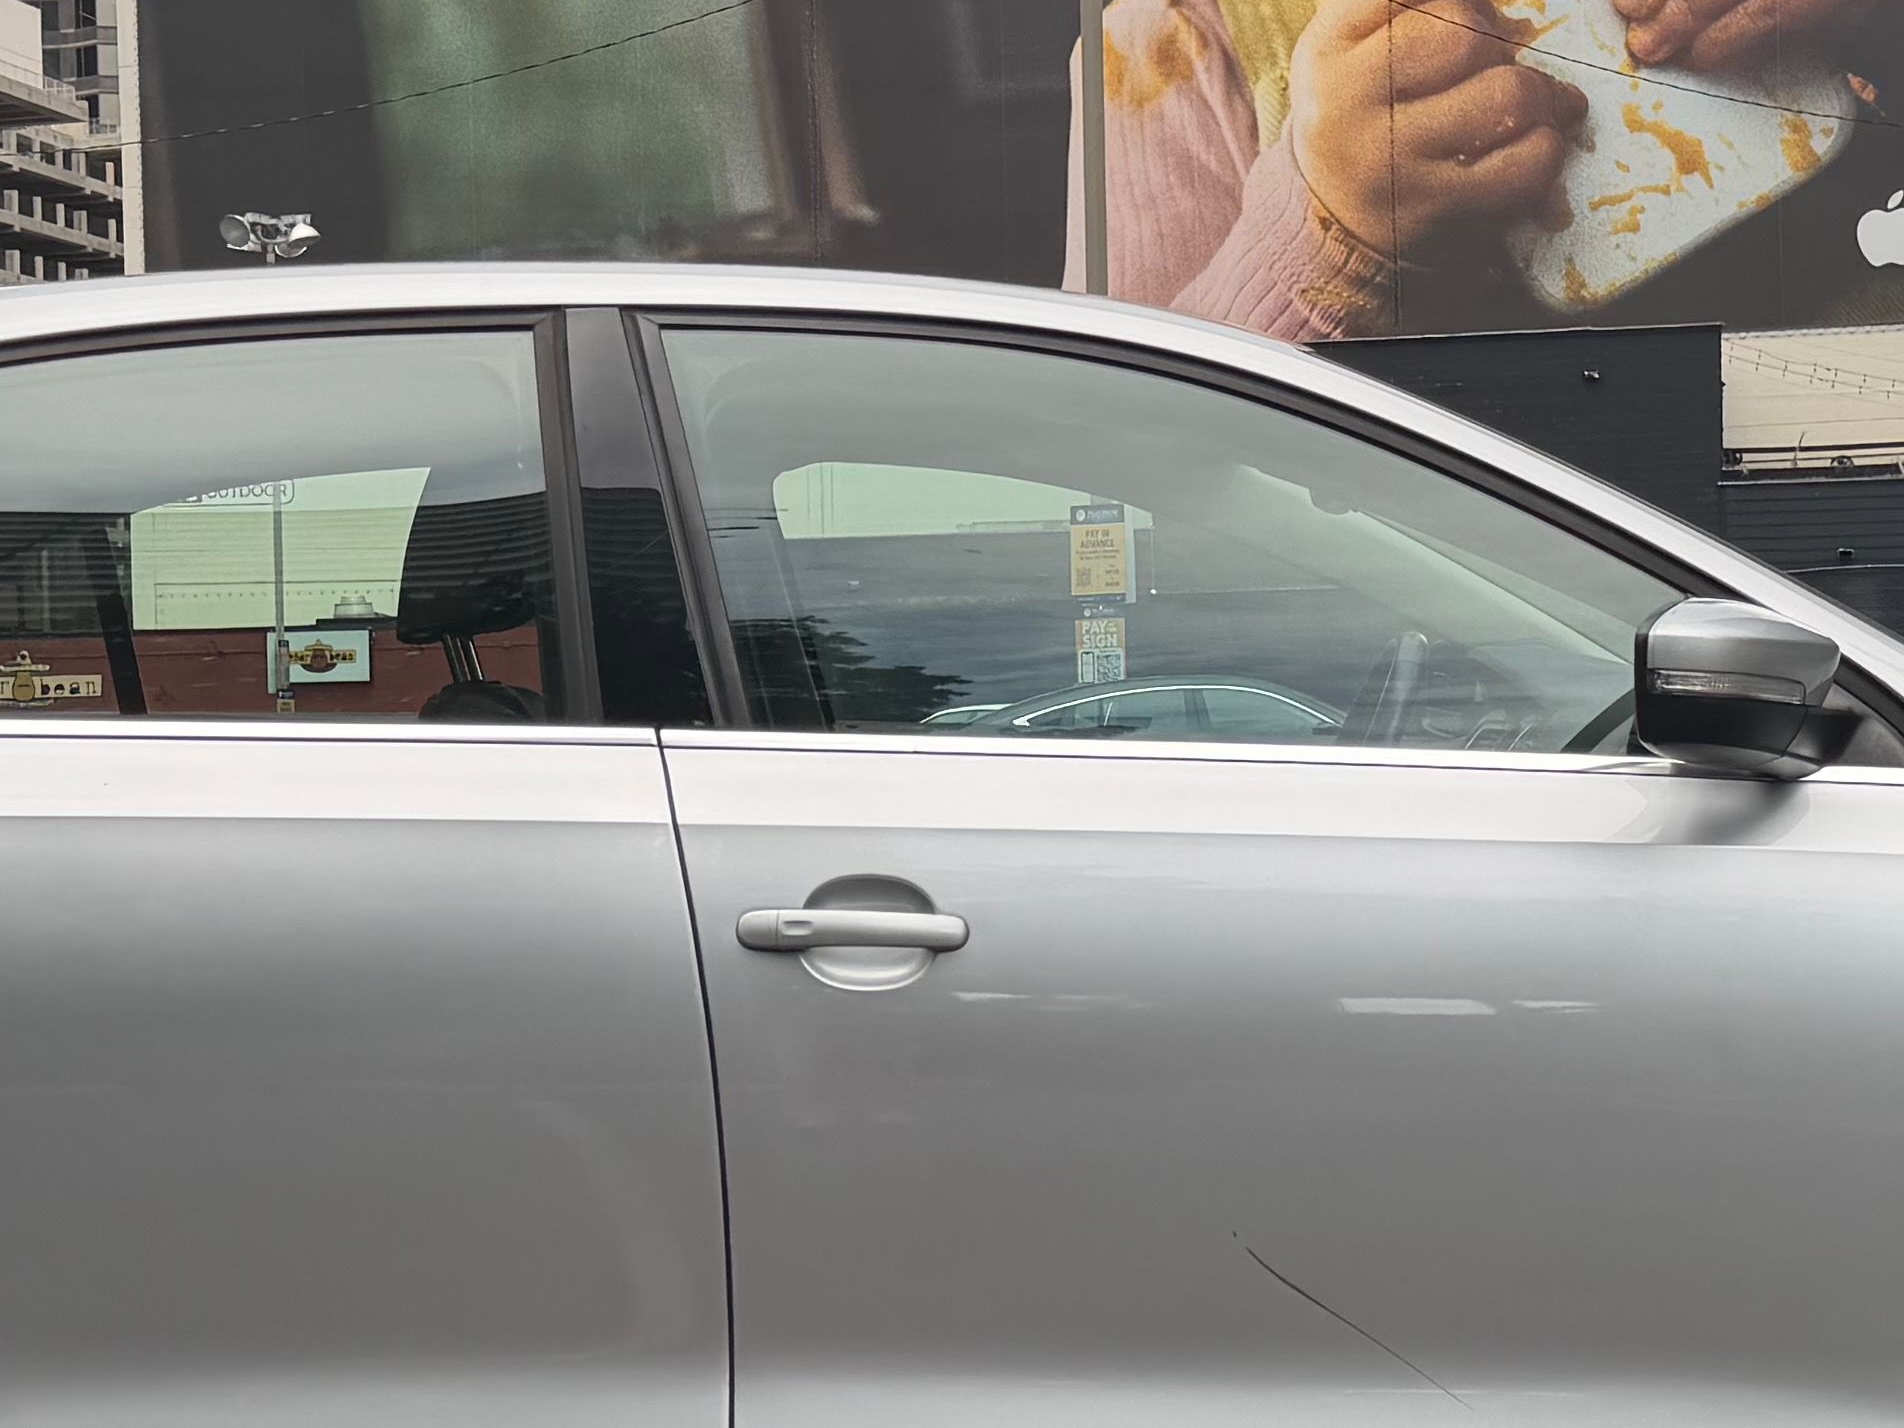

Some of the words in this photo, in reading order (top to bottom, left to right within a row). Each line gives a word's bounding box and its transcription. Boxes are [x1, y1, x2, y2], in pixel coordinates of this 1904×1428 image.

[1082, 618, 1107, 634] PAY
[1082, 633, 1118, 648] SIGN
[40, 678, 97, 696] bean
